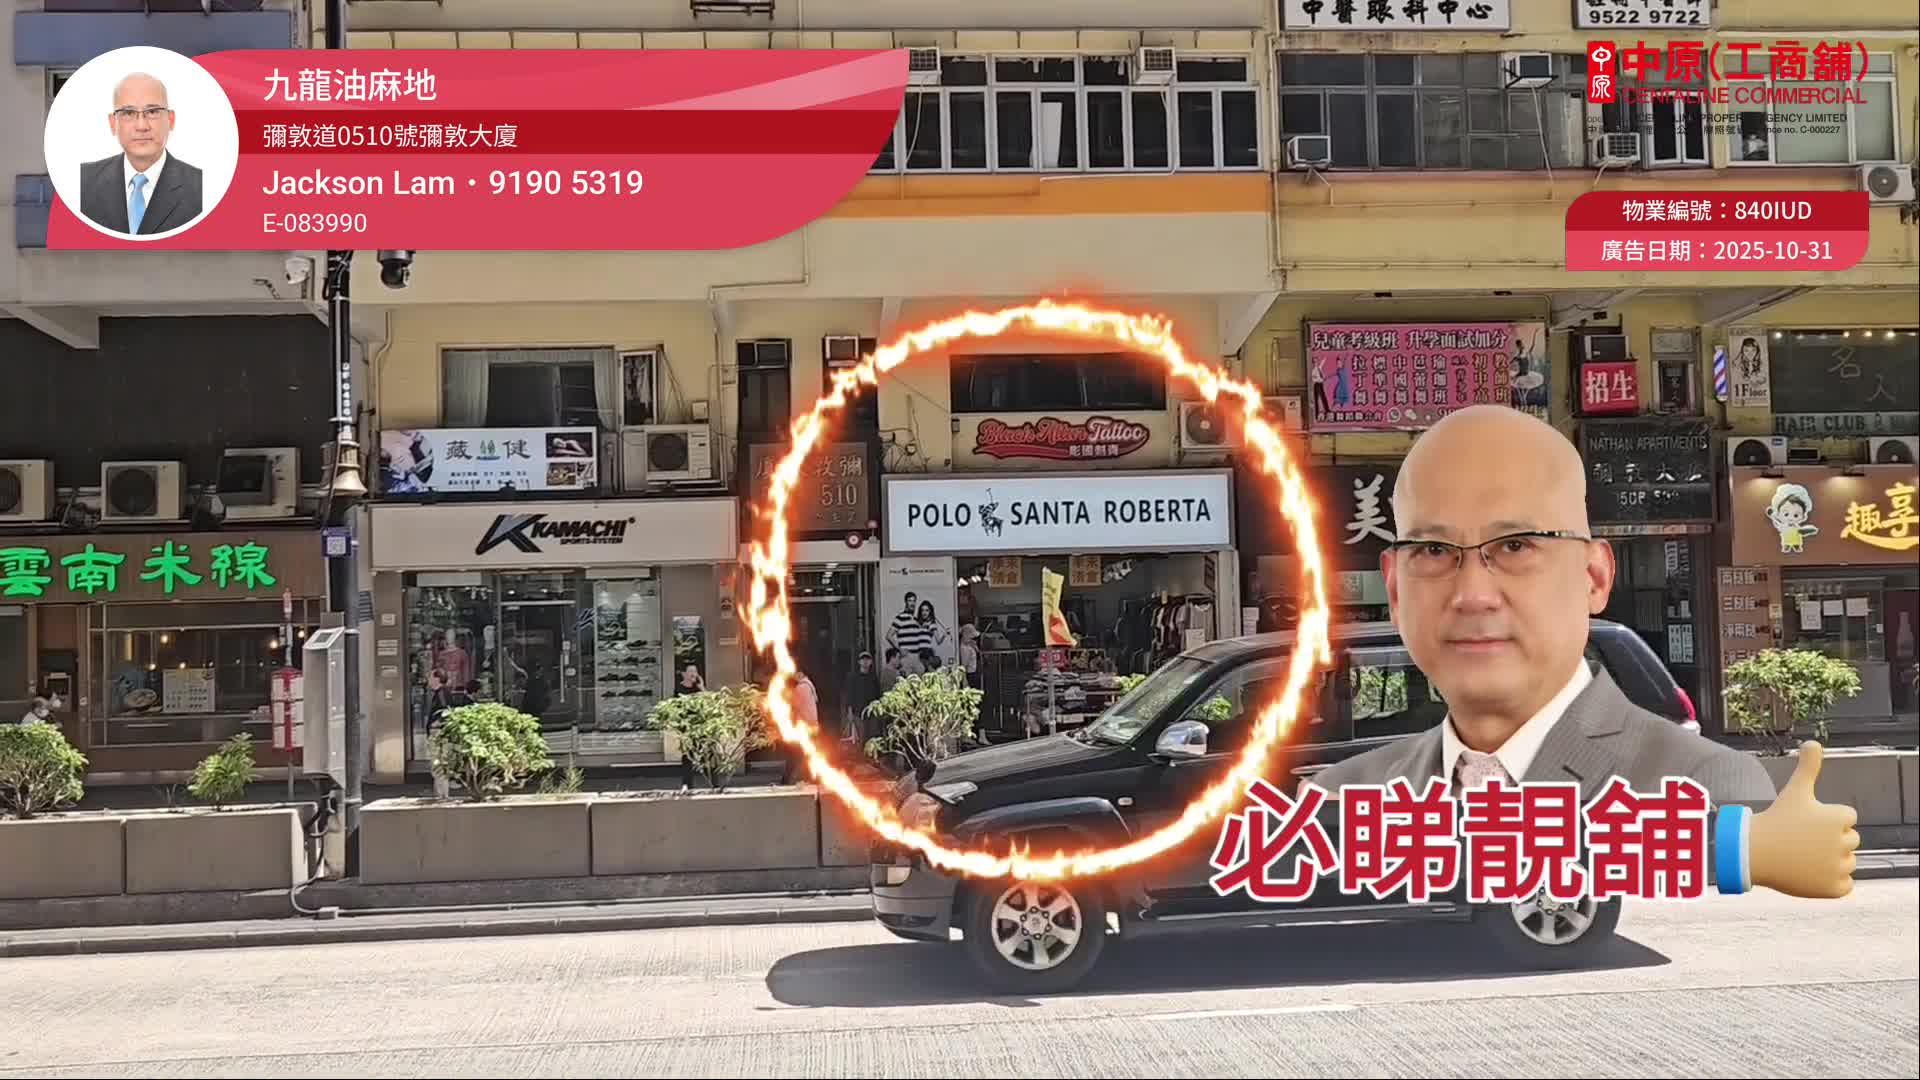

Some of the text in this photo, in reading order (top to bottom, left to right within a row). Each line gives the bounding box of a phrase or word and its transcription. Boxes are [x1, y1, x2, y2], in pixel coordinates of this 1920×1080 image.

[1589, 10, 1700, 23] 9522 9722
[1407, 329, 1507, 348] 升學面試加分
[1585, 370, 1635, 404] 招生
[1087, 417, 1144, 442] Tattoo
[1776, 416, 1816, 433] HAIR
[1823, 414, 1865, 431] CLUB
[1590, 434, 1708, 450] NATHAN APARTMENTS
[821, 483, 858, 506] 510
[908, 498, 1211, 527] POLO SANTA ROBERTA
[1343, 473, 1396, 545] 美
[530, 518, 628, 539] KAMACHI
[0, 539, 277, 597] 雲南米線
